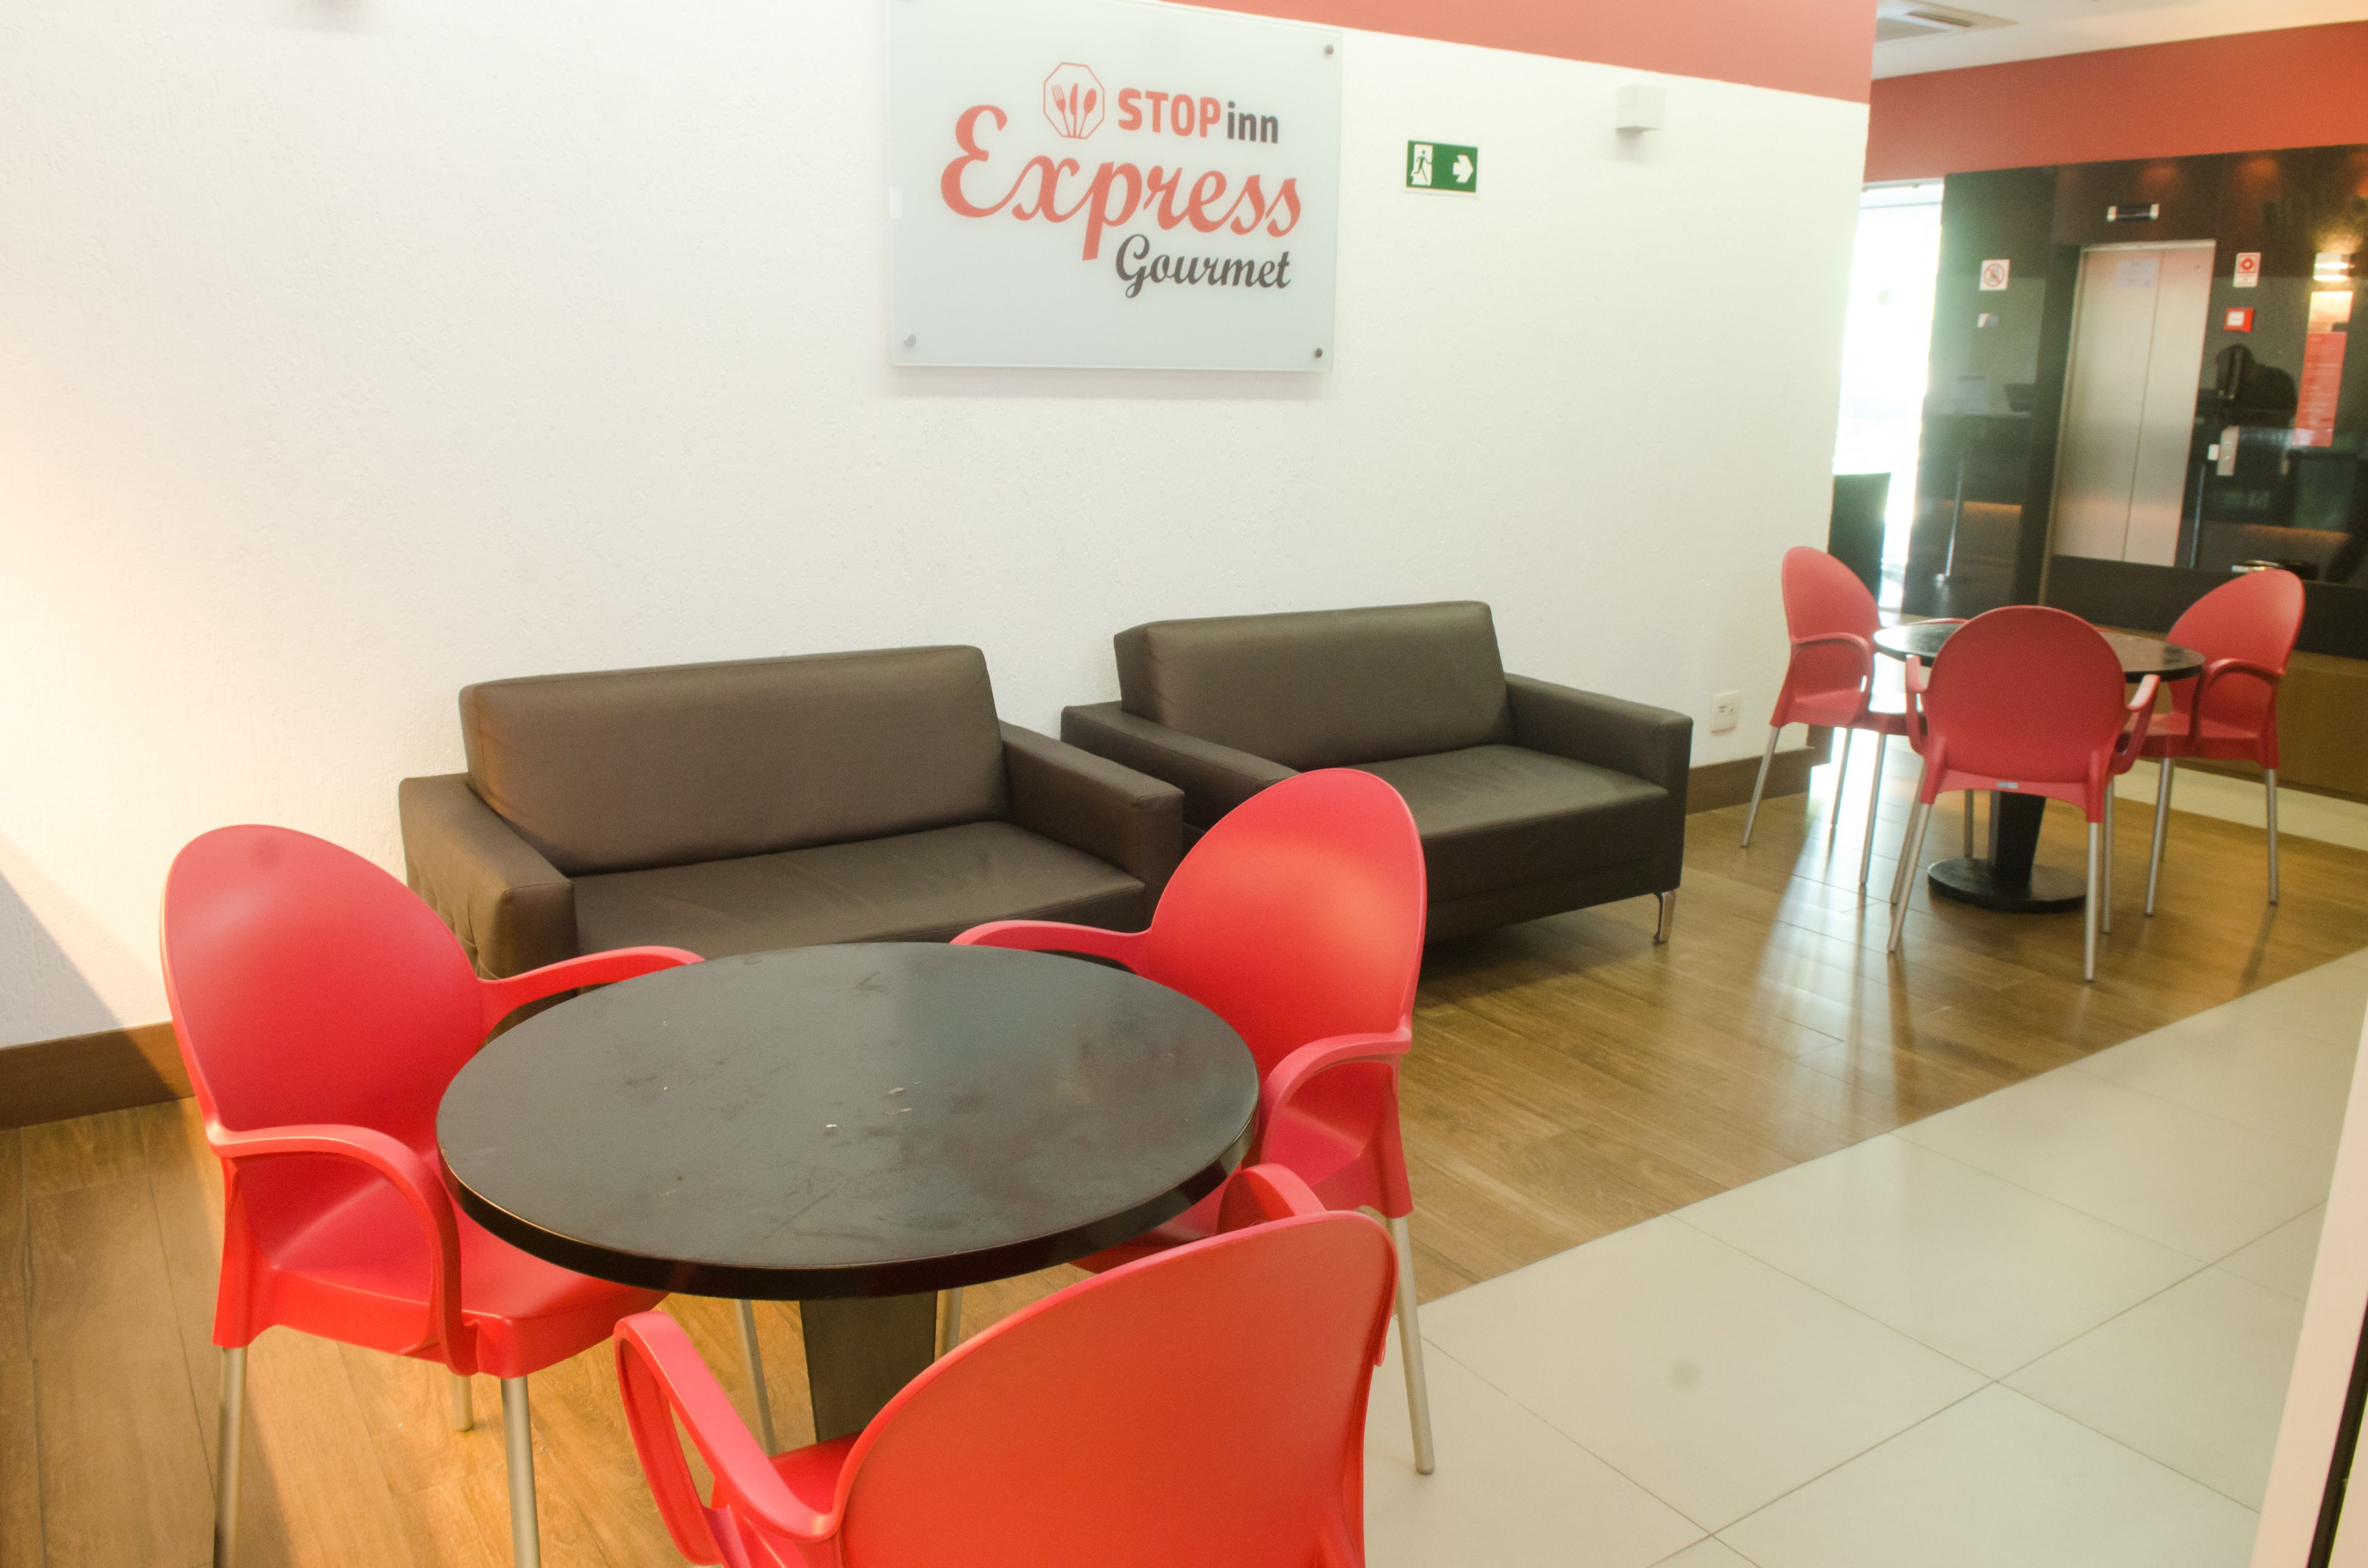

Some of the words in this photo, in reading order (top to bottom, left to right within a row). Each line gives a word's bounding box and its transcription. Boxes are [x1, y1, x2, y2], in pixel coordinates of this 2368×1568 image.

[1117, 88, 1222, 138] STOP
[940, 104, 1301, 261] Express
[1115, 233, 1291, 299] Gourmet
